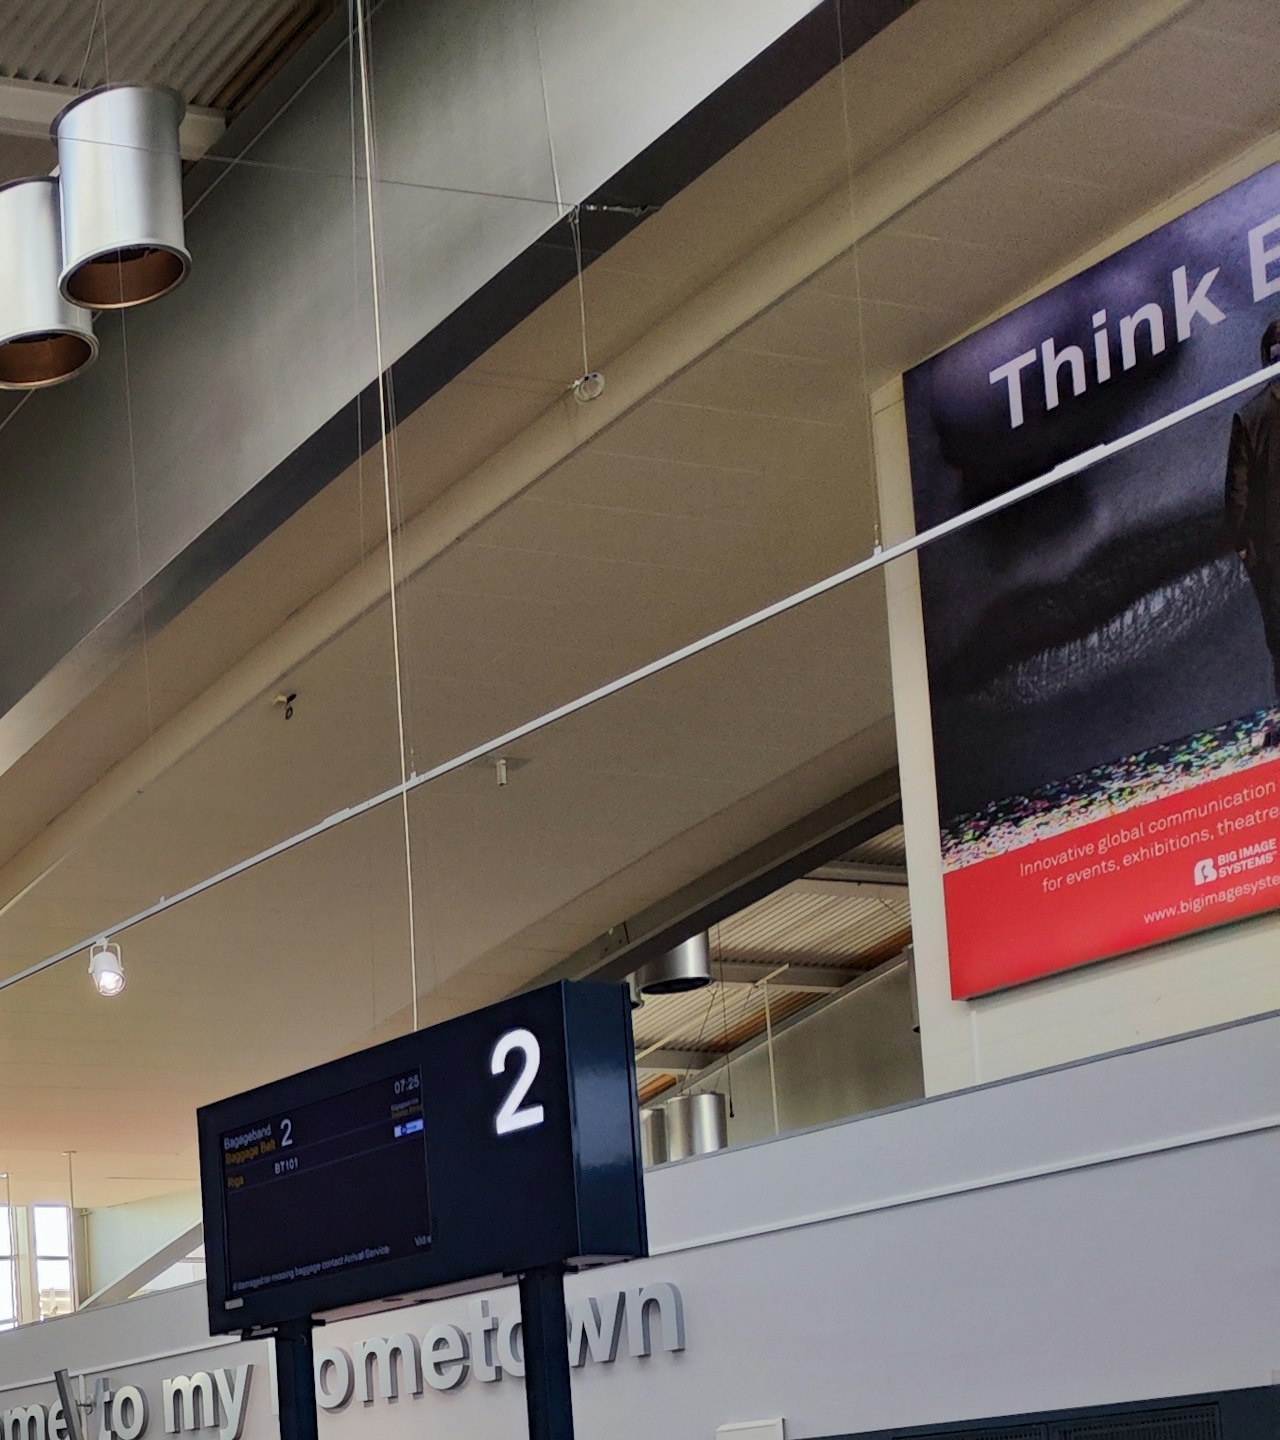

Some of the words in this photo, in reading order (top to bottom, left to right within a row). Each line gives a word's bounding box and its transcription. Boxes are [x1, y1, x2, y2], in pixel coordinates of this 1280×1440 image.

[989, 265, 1227, 430] Think
[1020, 842, 1094, 877] Innovative
[1097, 828, 1145, 854] global
[1148, 780, 1277, 834] communication
[1042, 876, 1063, 893] for
[1066, 860, 1121, 885] events,
[1123, 829, 1215, 867] exhibitions,
[1218, 851, 1238, 866] BIG
[1239, 838, 1278, 859] IMAGE
[491, 1028, 544, 1135] 2
[280, 1118, 293, 1147] 2
